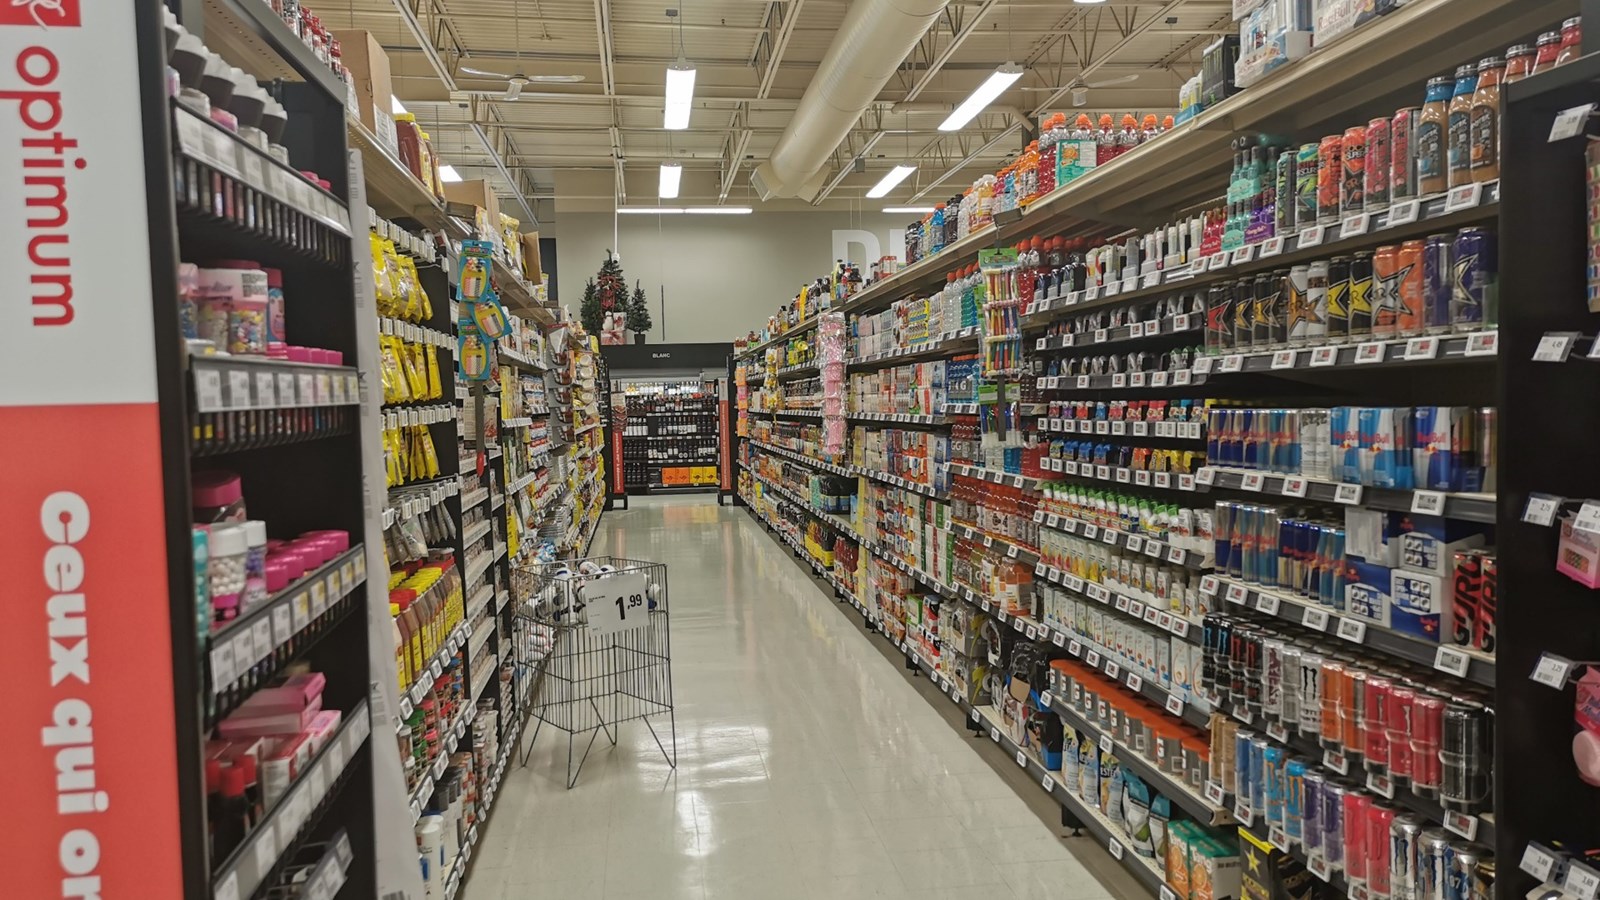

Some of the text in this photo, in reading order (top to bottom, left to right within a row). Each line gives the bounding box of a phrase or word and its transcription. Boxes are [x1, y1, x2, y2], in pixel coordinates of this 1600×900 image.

[0, 46, 87, 326] optimum
[41, 491, 90, 687] Ceux
[41, 698, 109, 815] qui
